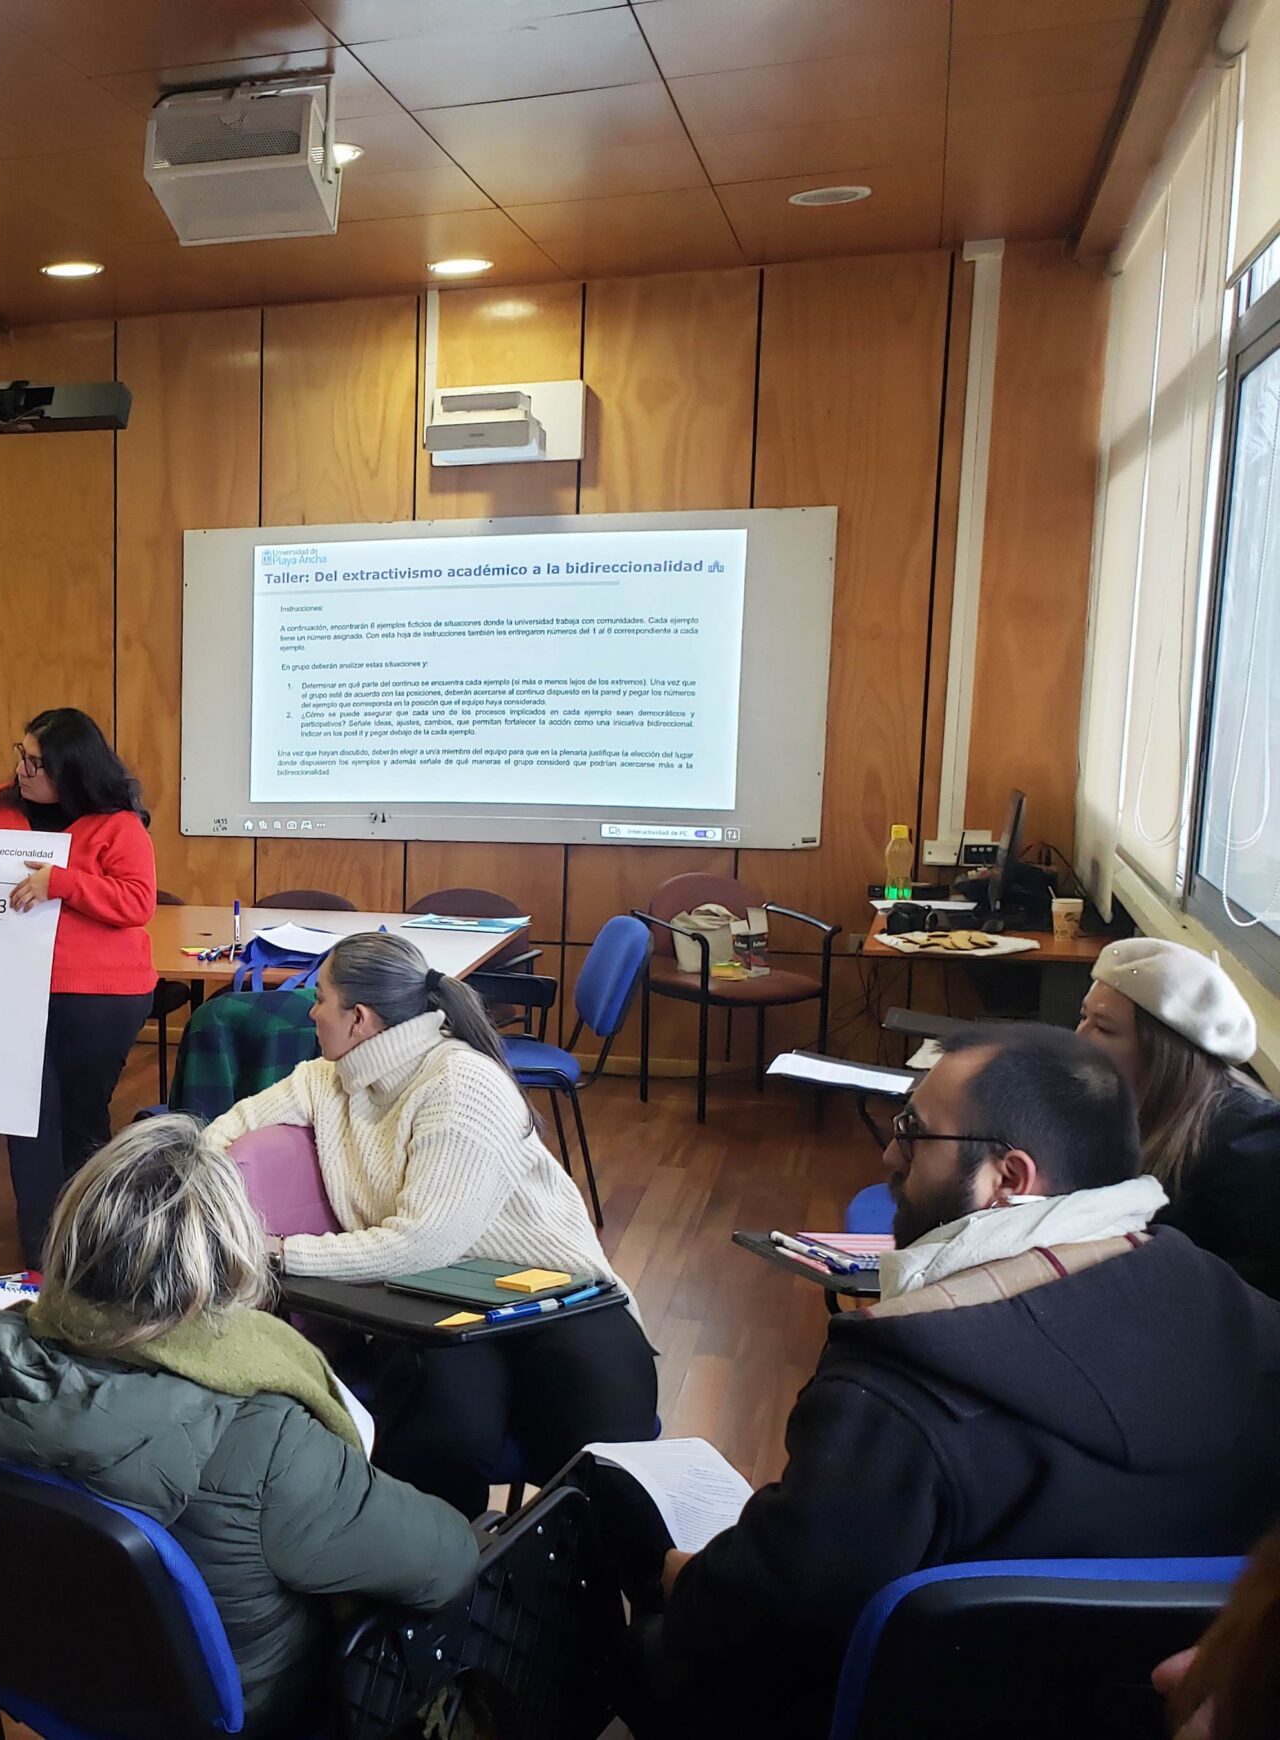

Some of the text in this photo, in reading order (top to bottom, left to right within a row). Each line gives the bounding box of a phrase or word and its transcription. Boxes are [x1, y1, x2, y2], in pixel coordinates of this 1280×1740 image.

[273, 555, 326, 567] Playa Ancha
[264, 560, 703, 584] Taller: Del extractivismo académico a la bidireccionalidad
[376, 620, 405, 630] ejemplos
[555, 617, 579, 626] trabaja
[669, 616, 698, 625] ejemplo
[396, 631, 410, 639] hoja
[508, 628, 545, 637] entregaron
[613, 627, 670, 635] correspondiente
[483, 678, 509, 686] ejemplo
[546, 688, 579, 697] dispuesto
[600, 688, 620, 697] pared
[312, 700, 337, 709] ejemplo
[352, 700, 392, 708] corresponda
[461, 698, 484, 707] equipo
[485, 698, 502, 706] haya
[339, 710, 359, 718] puede
[509, 708, 545, 717] implicados
[584, 709, 611, 717] ejemplo
[472, 718, 501, 726] permitan
